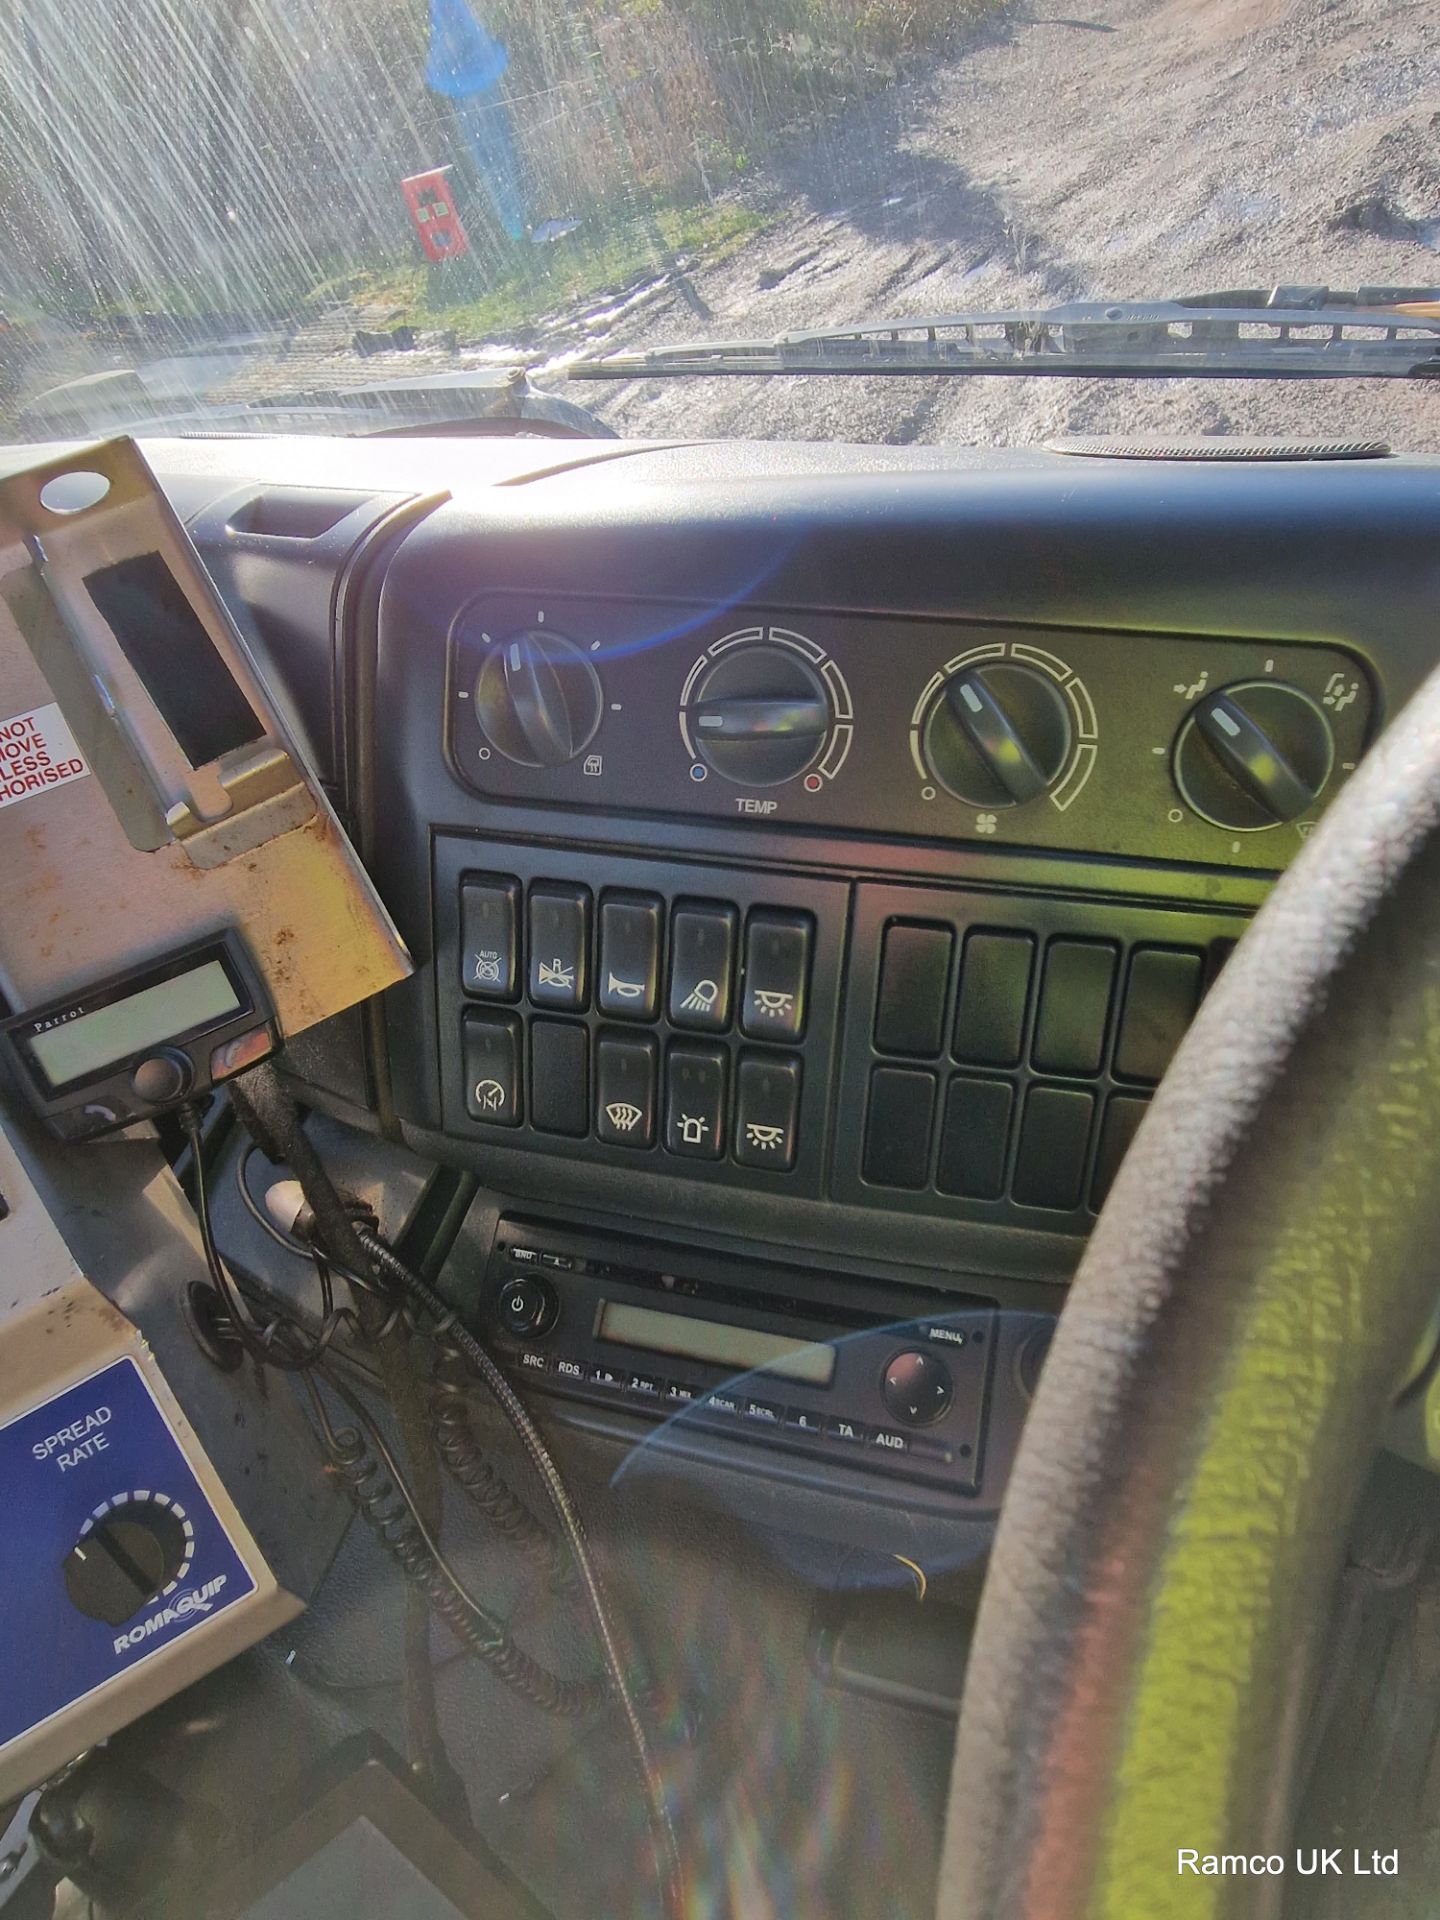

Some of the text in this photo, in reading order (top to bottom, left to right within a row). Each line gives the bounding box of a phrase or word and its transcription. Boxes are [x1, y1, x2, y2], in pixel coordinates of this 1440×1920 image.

[736, 797, 778, 815] TEMP
[479, 950, 498, 959] AUTO
[34, 1006, 85, 1033] Parrot
[523, 1354, 545, 1368] SRC
[558, 1361, 580, 1376] RDS
[632, 1377, 640, 1389] 2
[670, 1386, 677, 1397] 3
[799, 1416, 807, 1428] 6
[32, 1406, 112, 1461] SPREAD
[838, 1424, 854, 1438] TA
[875, 1432, 904, 1450] AUD
[56, 1432, 110, 1472] RATE
[113, 1574, 227, 1655] ROMAQUIP
